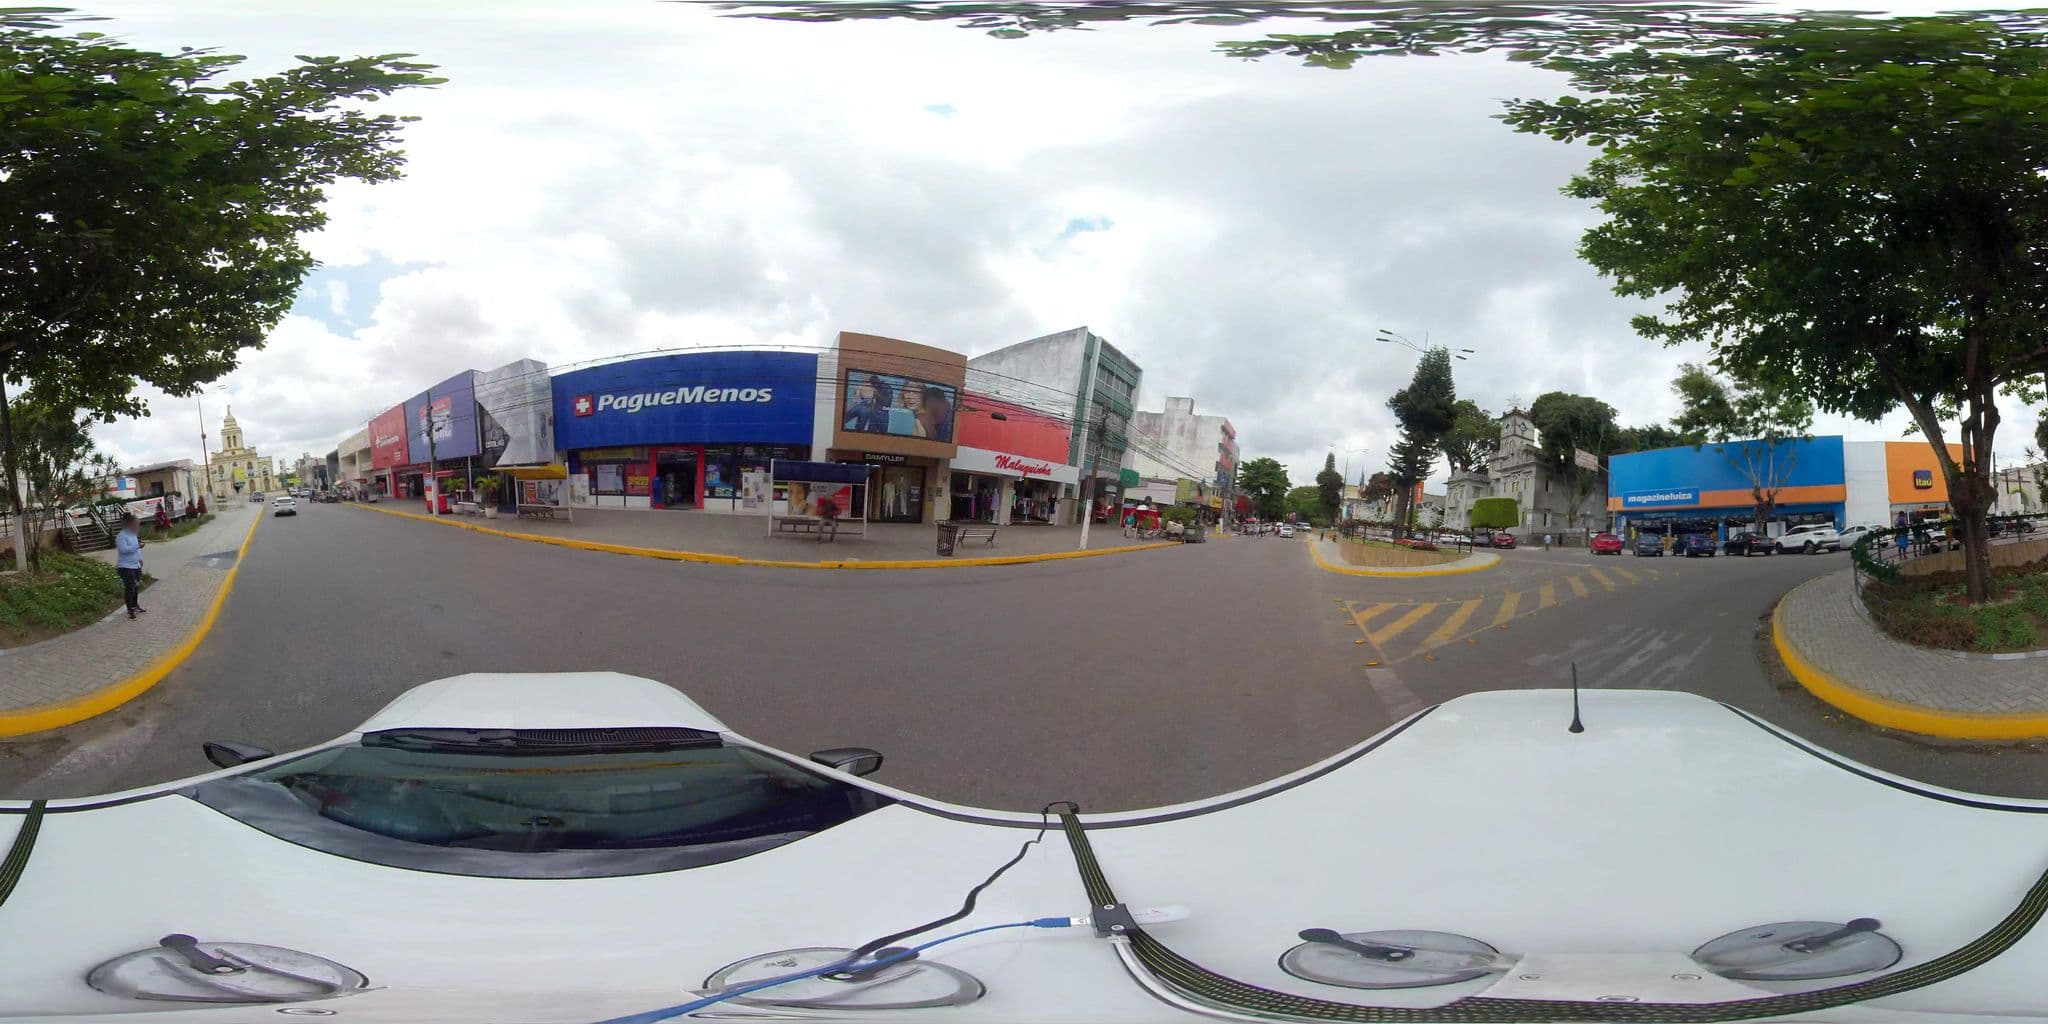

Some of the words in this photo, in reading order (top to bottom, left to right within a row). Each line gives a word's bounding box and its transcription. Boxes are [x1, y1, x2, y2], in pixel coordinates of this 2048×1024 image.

[598, 385, 773, 413] PagueMenos
[865, 453, 905, 463] DAMYLLER
[995, 454, 1052, 478] Maluquinha
[1627, 492, 1693, 504] magazineluiza
